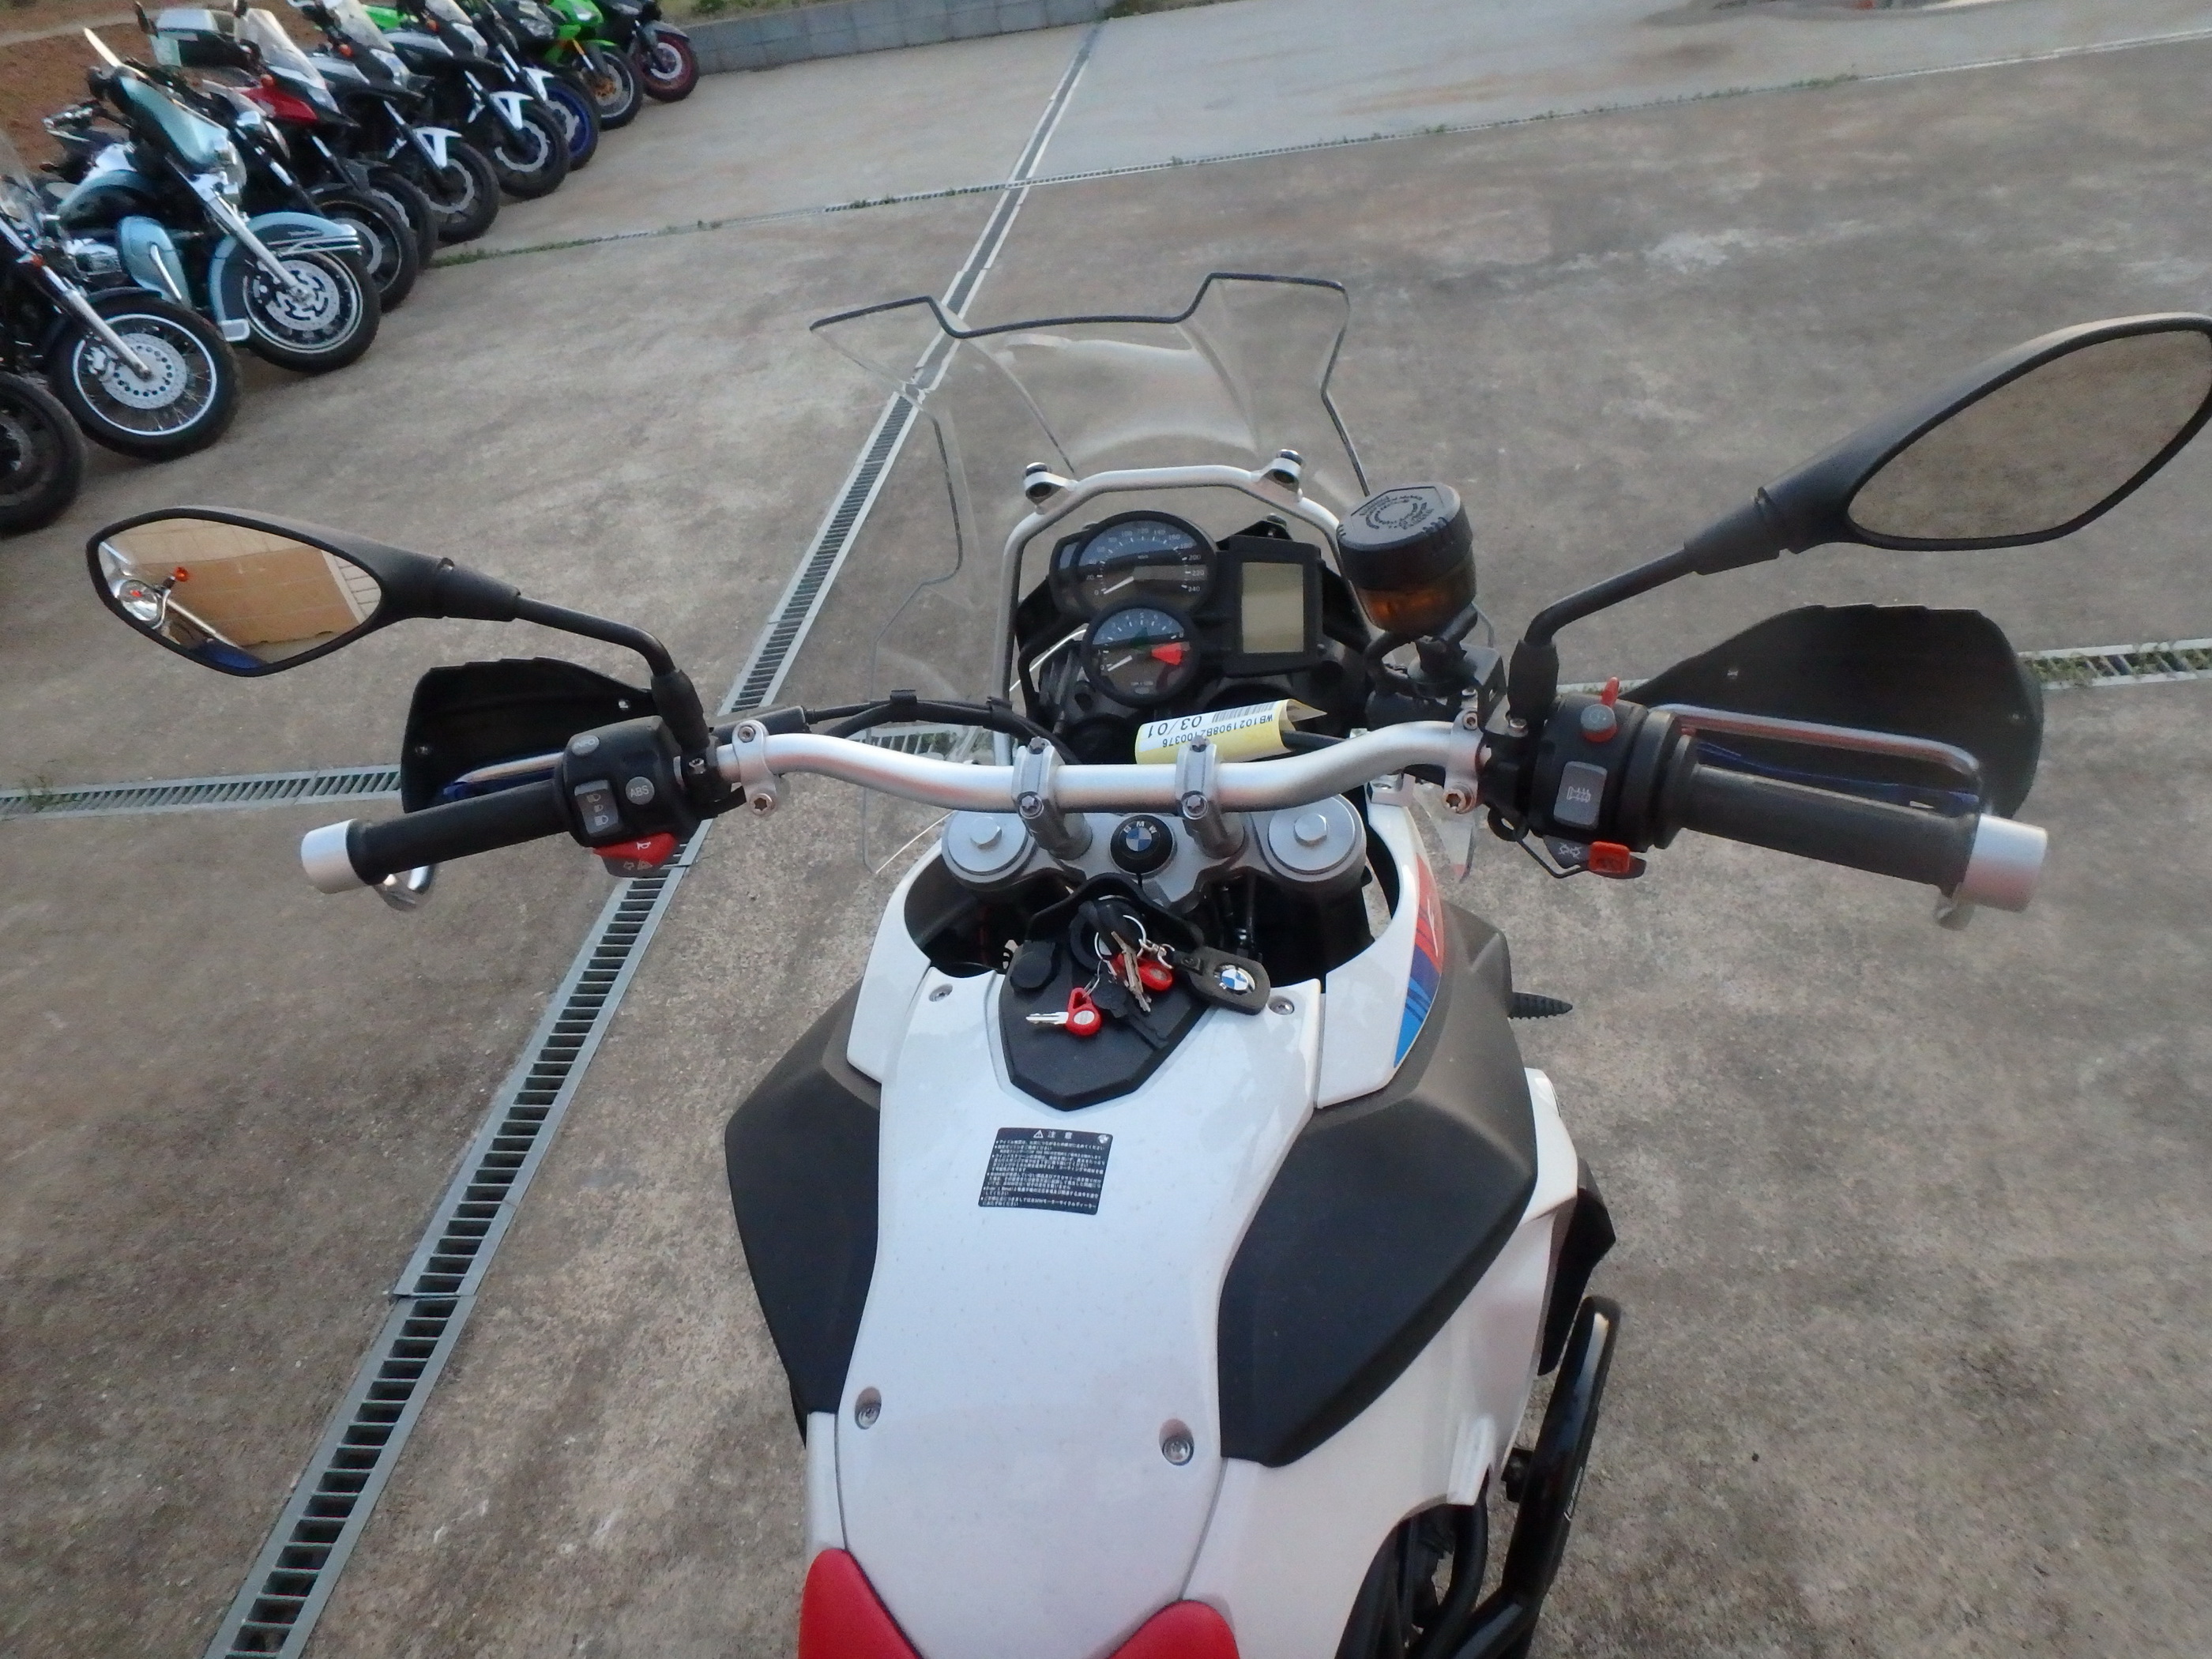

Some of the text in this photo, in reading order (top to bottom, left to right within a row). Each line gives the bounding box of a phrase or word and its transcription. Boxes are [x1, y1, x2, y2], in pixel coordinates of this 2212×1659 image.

[1148, 715, 1202, 739] 03/01
[630, 784, 649, 798] ABS
[1123, 821, 1158, 833] BMW
